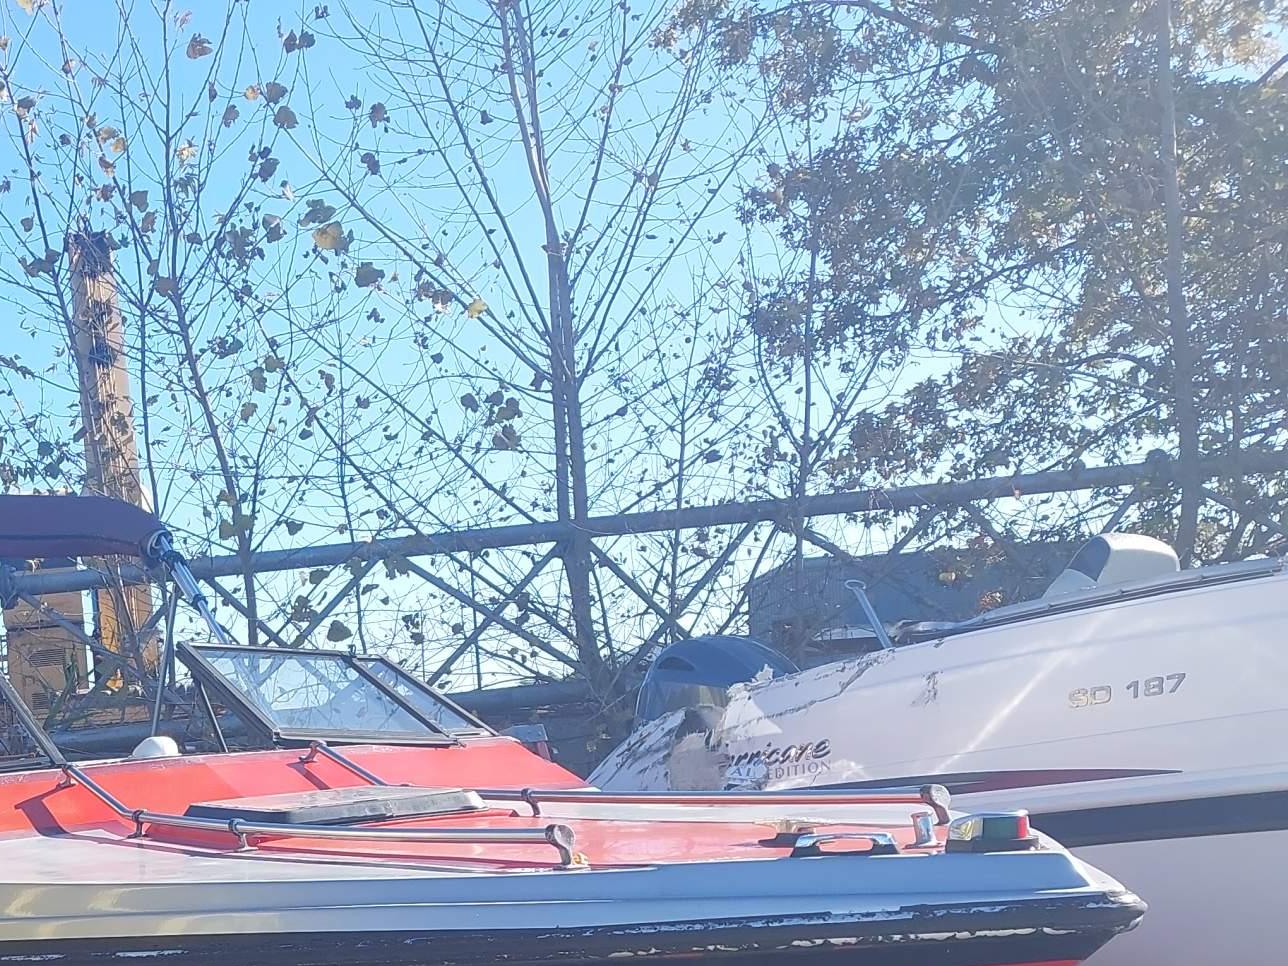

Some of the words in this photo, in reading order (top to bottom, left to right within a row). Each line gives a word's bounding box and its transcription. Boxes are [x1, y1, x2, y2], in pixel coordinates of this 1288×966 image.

[1069, 685, 1112, 708] SD
[1125, 672, 1186, 699] 187
[767, 760, 831, 780] EDITION
